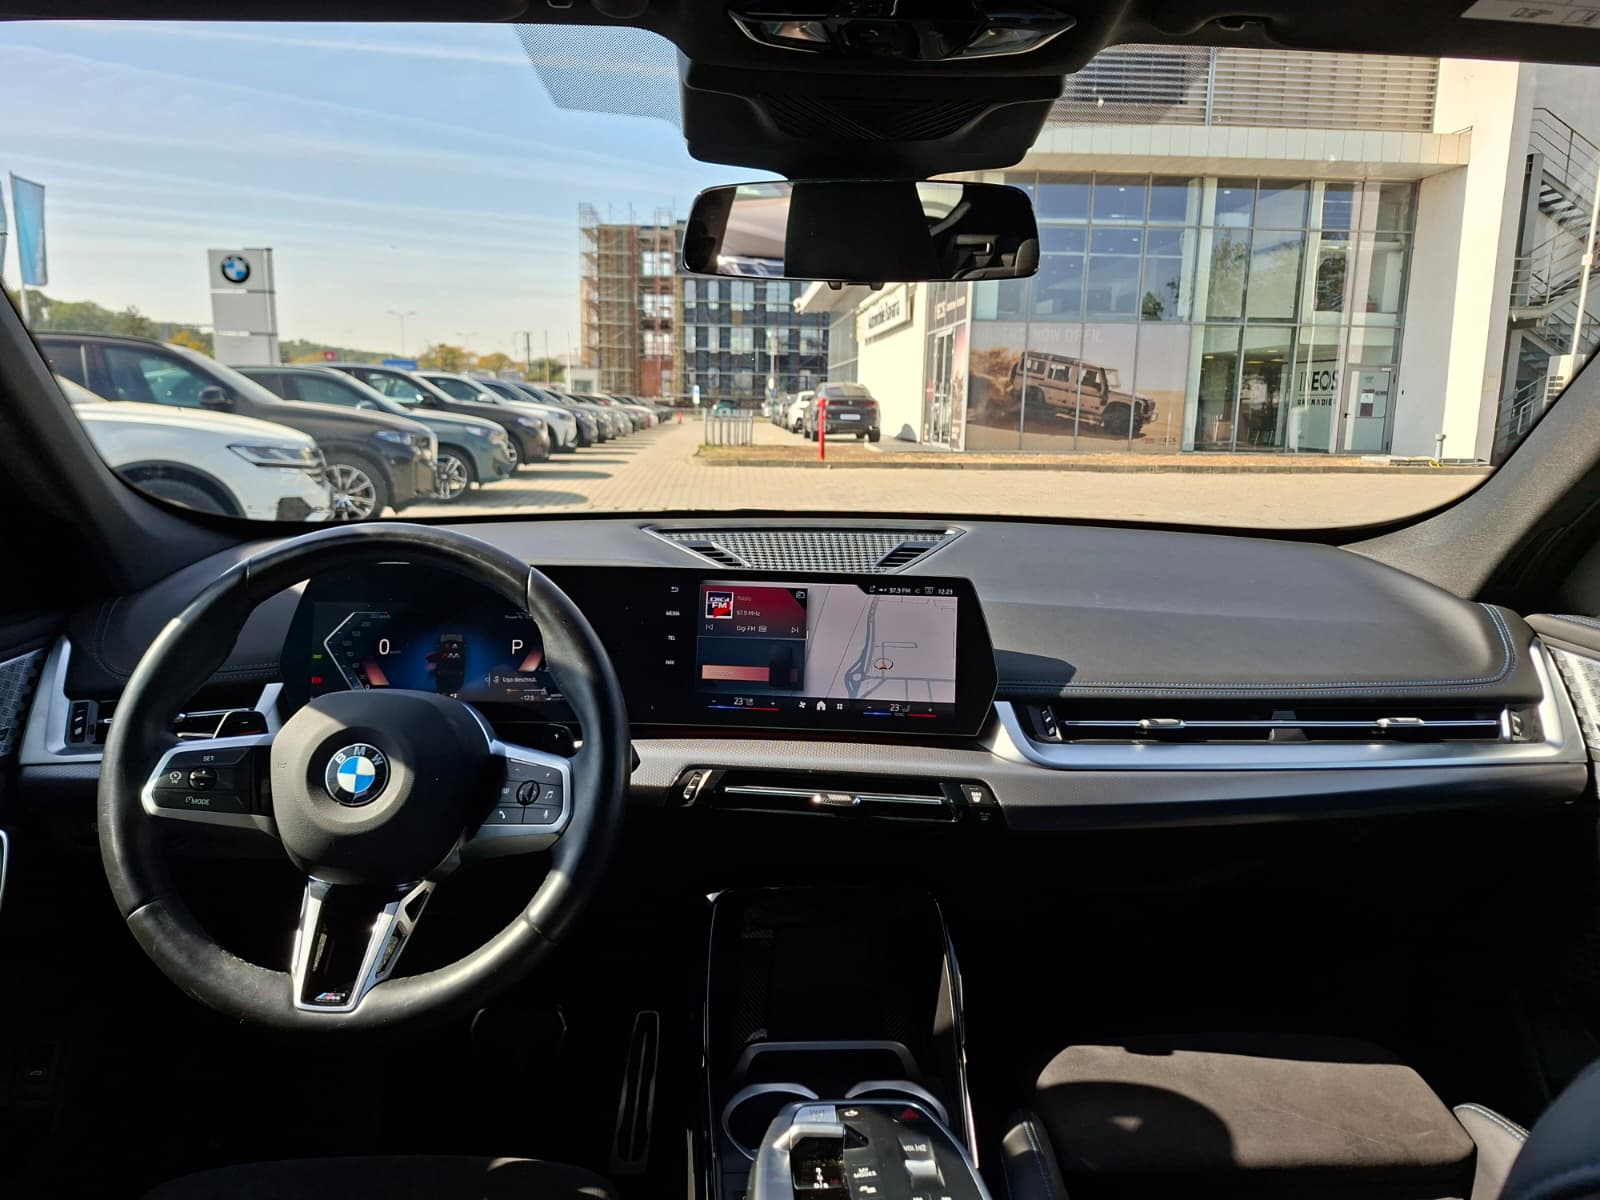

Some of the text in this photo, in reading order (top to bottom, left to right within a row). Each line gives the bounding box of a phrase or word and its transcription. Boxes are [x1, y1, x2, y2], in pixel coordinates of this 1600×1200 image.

[711, 601, 728, 609] FM
[378, 638, 390, 656] 0
[511, 639, 524, 656] P
[334, 746, 384, 767] BMW
[191, 798, 211, 806] MODE
